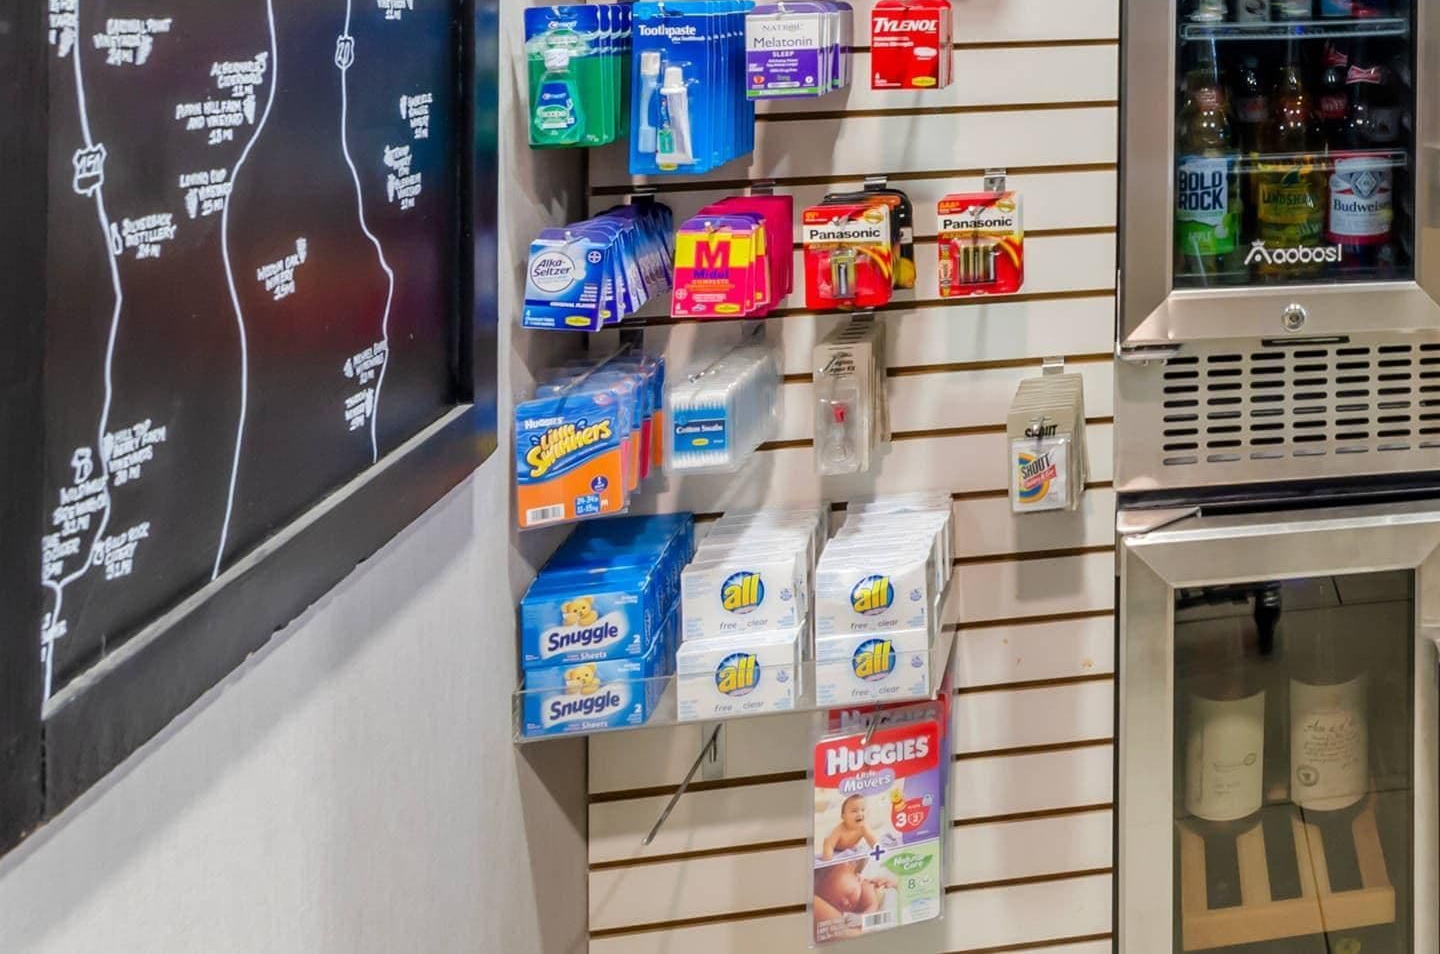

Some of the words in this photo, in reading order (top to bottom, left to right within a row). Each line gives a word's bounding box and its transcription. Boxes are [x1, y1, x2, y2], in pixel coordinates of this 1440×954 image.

[638, 24, 697, 37] Toothpaste
[873, 17, 938, 33] TYLENOL
[753, 37, 813, 48] Melatonin
[1178, 170, 1223, 191] BOLD
[1178, 188, 1225, 211] ROCK
[943, 217, 1013, 230] Panasonic
[809, 228, 880, 240] Panasonic
[695, 240, 731, 268] M
[538, 258, 566, 267] Alka-
[533, 267, 570, 277] Seltzer
[1020, 452, 1050, 480] SHOUT
[723, 572, 761, 610] all
[854, 575, 890, 613] all
[719, 621, 737, 631] free
[747, 618, 768, 628] clear
[850, 622, 868, 631] free
[878, 618, 899, 628] clear
[548, 622, 618, 652] Snuggle
[633, 634, 641, 643] 2
[580, 651, 608, 661] Sheets
[855, 639, 893, 678] all
[718, 653, 757, 692] all
[878, 685, 900, 695] clear
[549, 690, 620, 721] Snuggle
[743, 700, 764, 710] clear
[826, 736, 930, 776] HUGGIES
[843, 771, 892, 793] Movers
[895, 813, 907, 828] 3
